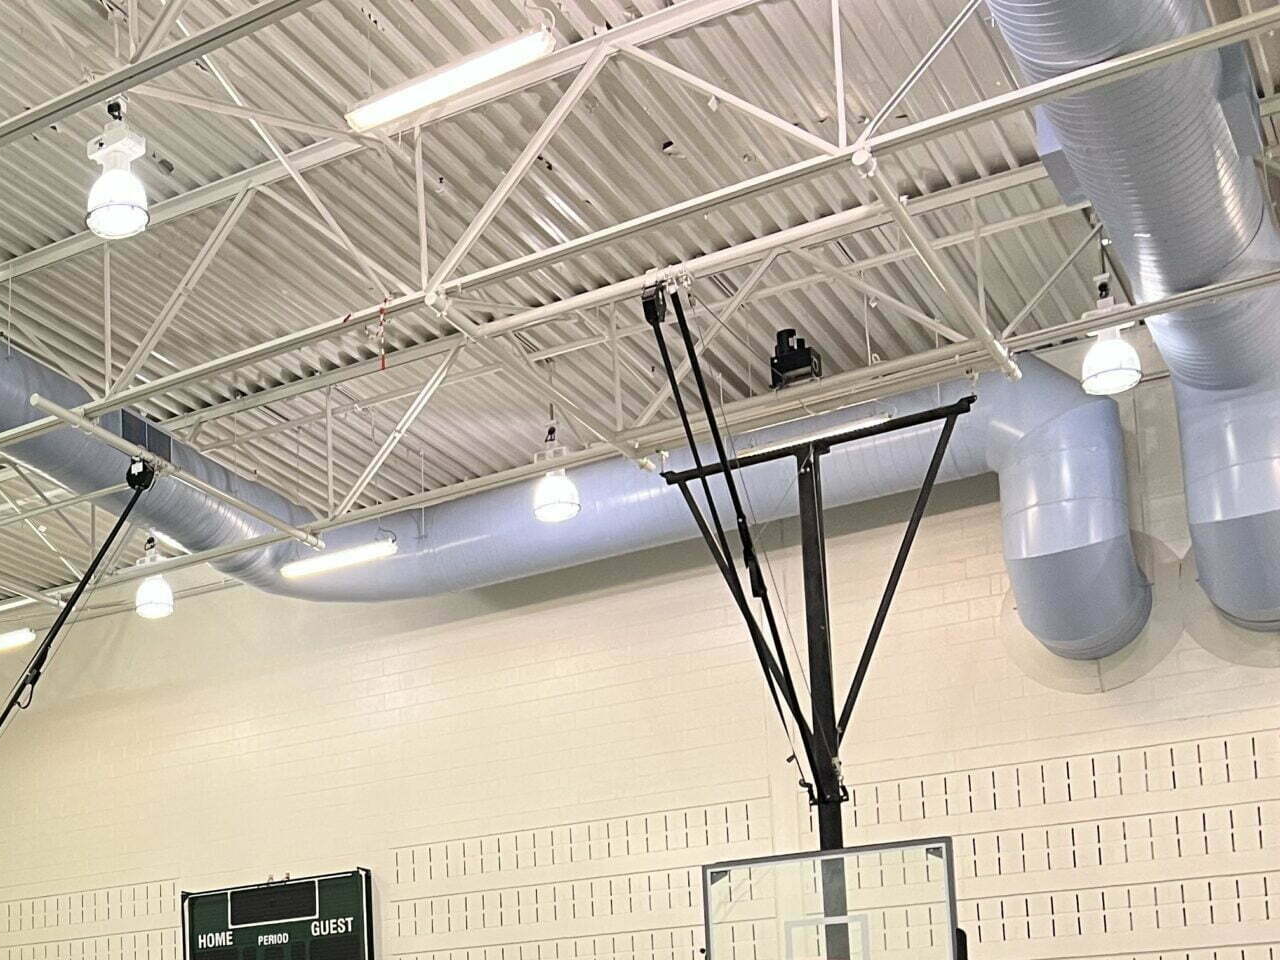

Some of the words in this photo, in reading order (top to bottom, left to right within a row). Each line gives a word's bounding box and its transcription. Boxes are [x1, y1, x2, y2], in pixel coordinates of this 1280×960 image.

[310, 917, 354, 937] GUEST
[198, 931, 233, 949] HOME
[258, 933, 289, 946] PERIOD
